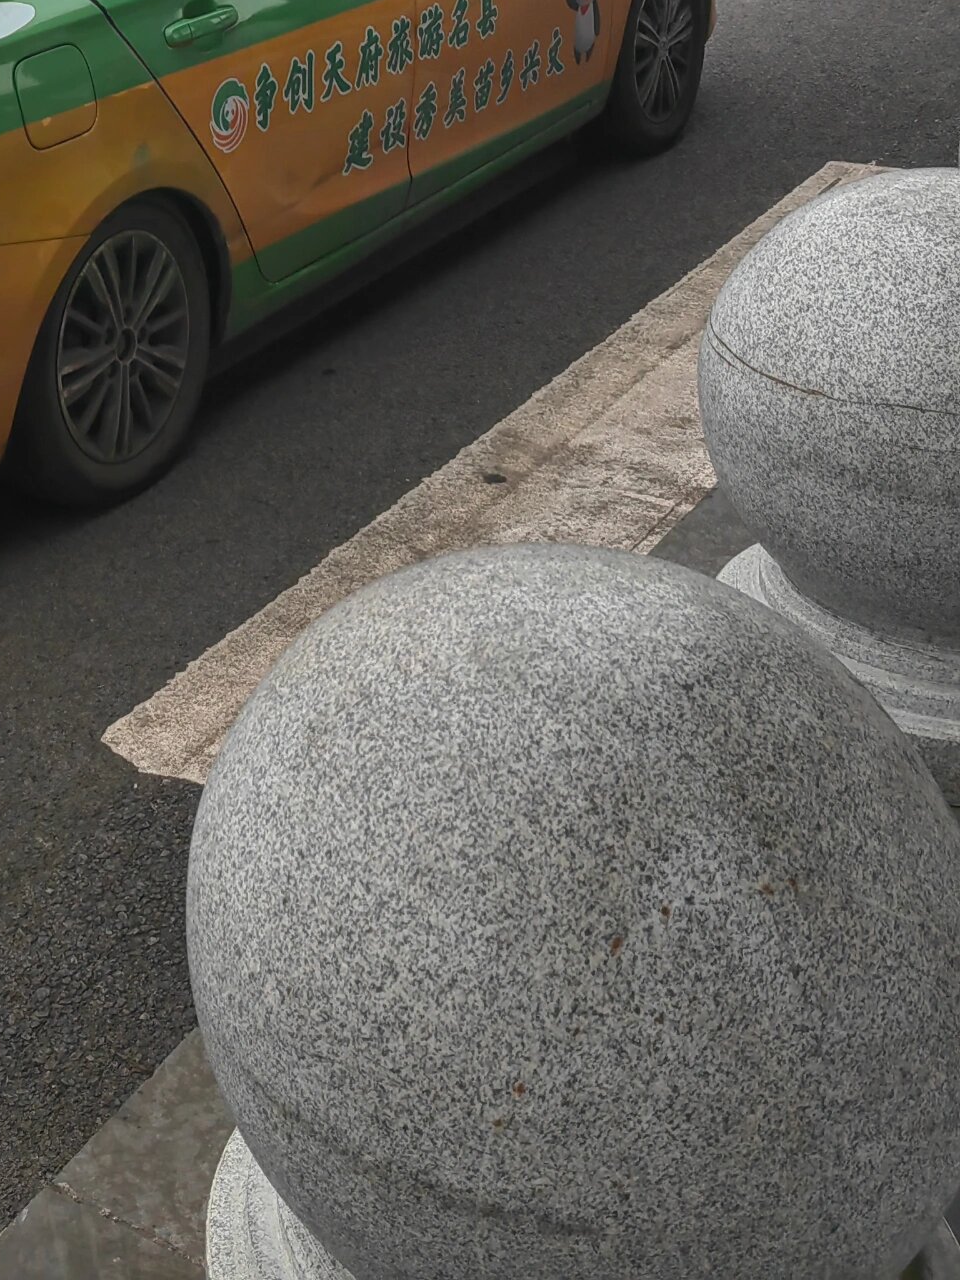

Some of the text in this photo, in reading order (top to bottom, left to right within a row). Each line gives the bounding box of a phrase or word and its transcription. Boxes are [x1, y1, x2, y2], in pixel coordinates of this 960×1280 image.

[342, 26, 566, 177] 建设秀美苗乡兴文
